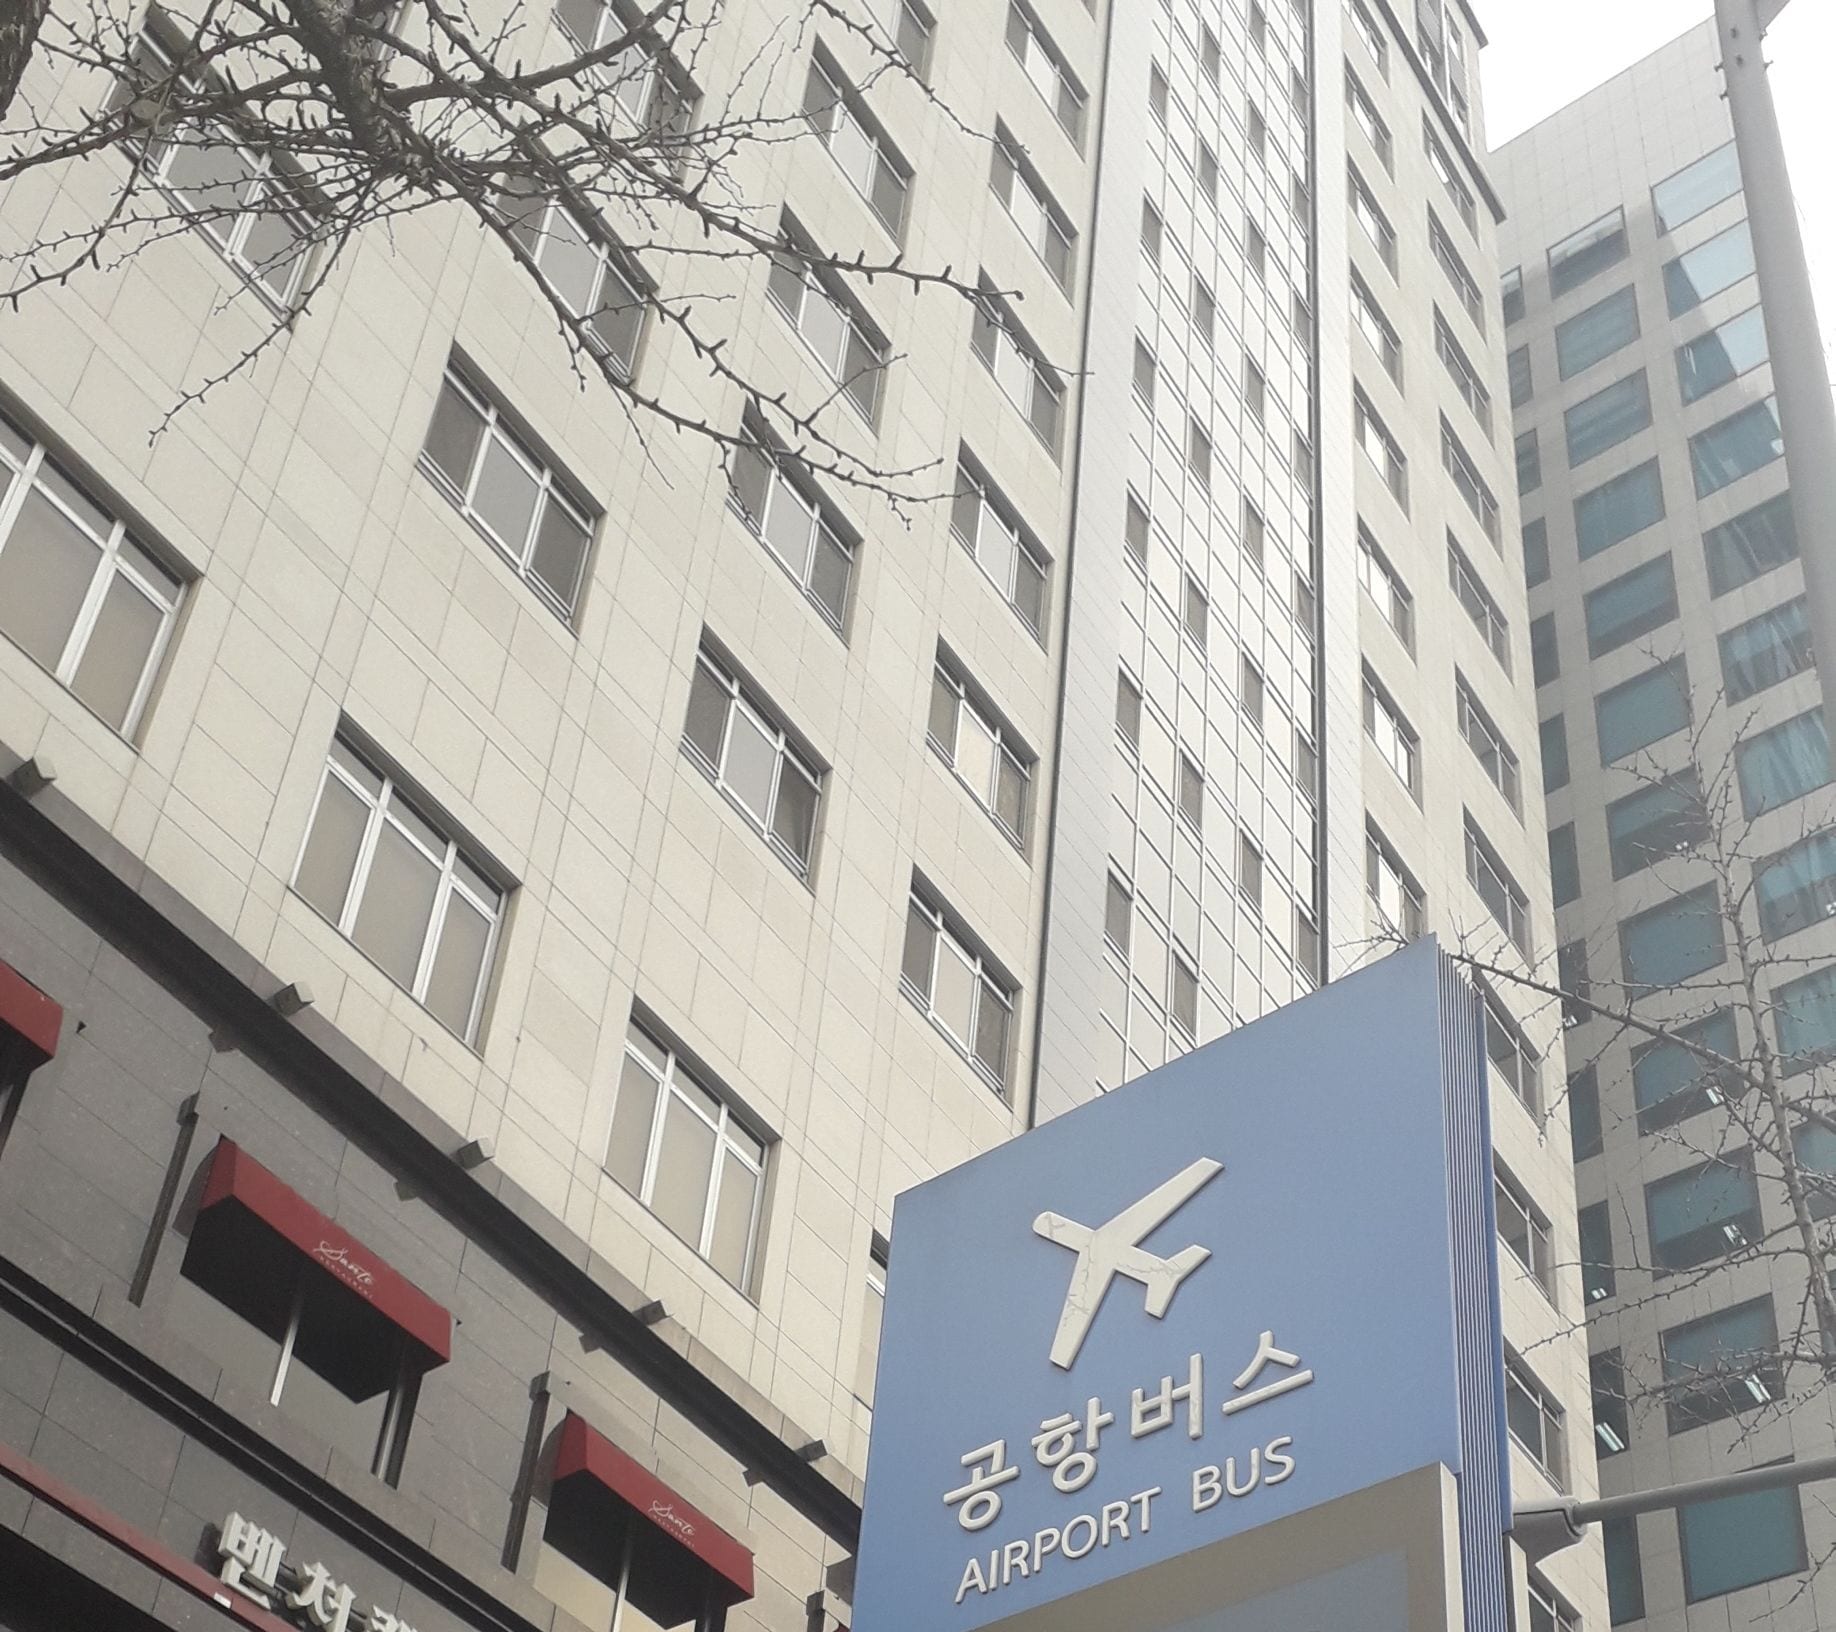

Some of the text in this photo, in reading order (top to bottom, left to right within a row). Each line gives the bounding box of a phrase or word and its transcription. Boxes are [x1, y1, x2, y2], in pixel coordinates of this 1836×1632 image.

[943, 1329, 1314, 1531] 공항버스
[954, 1435, 1296, 1603] AIRPORT BUS
